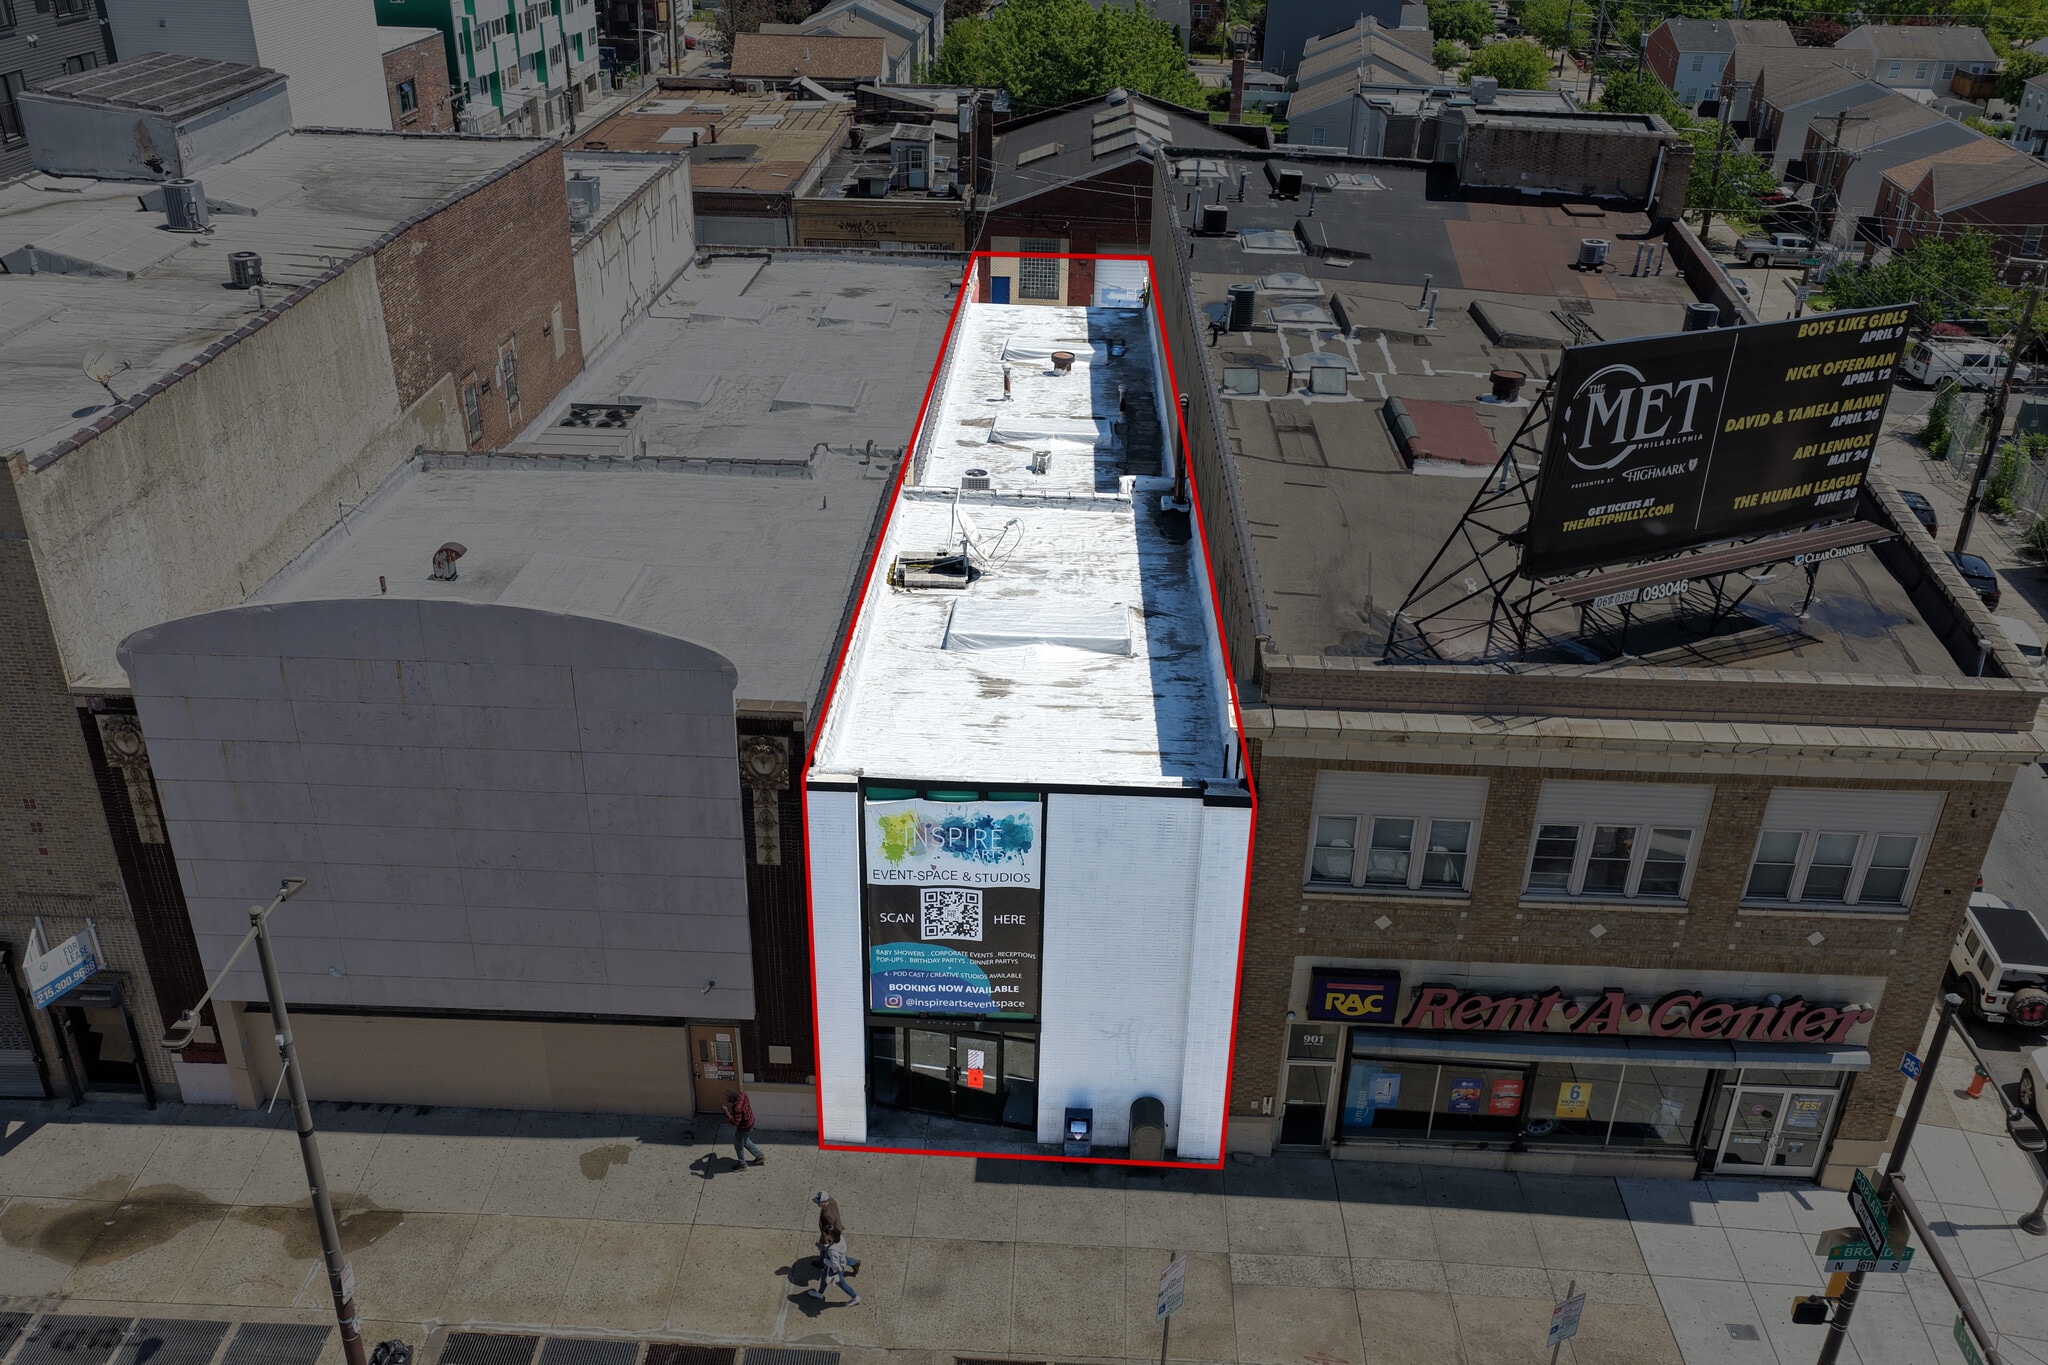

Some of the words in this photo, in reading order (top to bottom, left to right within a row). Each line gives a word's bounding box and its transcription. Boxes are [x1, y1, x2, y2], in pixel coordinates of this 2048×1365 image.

[1798, 322, 1835, 338] BOYS
[1837, 316, 1866, 333] LIKE
[1869, 310, 1908, 328] GIRLS
[1860, 329, 1893, 343] APRIL
[1895, 327, 1903, 338] 9
[1785, 363, 1824, 381] NICK
[1823, 352, 1897, 375] OFFERMAN
[1841, 372, 1874, 386] APRIL
[1878, 368, 1892, 380] 12
[1588, 384, 1606, 394] THE
[1578, 376, 1713, 449] MET
[1725, 413, 1771, 432] DAVID
[1772, 410, 1783, 423] &
[1788, 401, 1839, 422] TAMELA
[1840, 393, 1885, 412] MANN
[1830, 412, 1863, 428] APRIL
[1865, 409, 1880, 421] 26
[1637, 433, 1703, 450] PHILADELPHIA
[1793, 444, 1819, 460] ARI
[1819, 433, 1874, 455] LENNOX
[1827, 452, 1853, 467] MAY
[1854, 449, 1869, 460] 24
[1626, 462, 1687, 482] HIGHMARK
[1571, 479, 1604, 489] PRESENTED
[1733, 494, 1759, 510] THE
[1760, 483, 1813, 505] HUMAN
[1813, 472, 1862, 493] LEAGUE
[1814, 491, 1842, 507] JUNE
[1843, 487, 1858, 499] 28
[1588, 506, 1606, 516] GET
[1607, 499, 1642, 513] TICKETS
[1643, 498, 1655, 507] AT
[1562, 503, 1675, 532] THEMETPHILLY.COM
[1643, 579, 1689, 601] 093046
[905, 827, 1004, 850] INSPIRE
[972, 849, 1005, 859] ARTS
[872, 869, 958, 881] EVENT-SPACE
[963, 872, 972, 881] &
[975, 872, 1031, 883] STUDIOS
[879, 913, 915, 923] SCAN
[994, 915, 1026, 925] HERE
[63, 941, 78, 957] FOR
[65, 944, 89, 966] LEASE
[37, 960, 96, 1004] 215.300.9688
[889, 983, 936, 992] BOOKING
[938, 984, 963, 993] NOW
[965, 985, 1019, 994] AVAILABLE
[905, 998, 1025, 1009] @inspireartseventspace
[1324, 993, 1384, 1016] RAC
[1303, 1035, 1324, 1043] 901
[1569, 1085, 1581, 1100] 6
[1354, 1090, 1367, 1123] amazon
[1795, 1101, 1821, 1110] YES!
[1857, 1172, 1880, 1219] POPLAR
[1859, 1203, 1869, 1225] ONE
[1868, 1223, 1880, 1245] WAY
[1844, 1247, 1893, 1257] BROD
[1834, 1262, 1844, 1270] N
[1891, 1262, 1899, 1271] S
